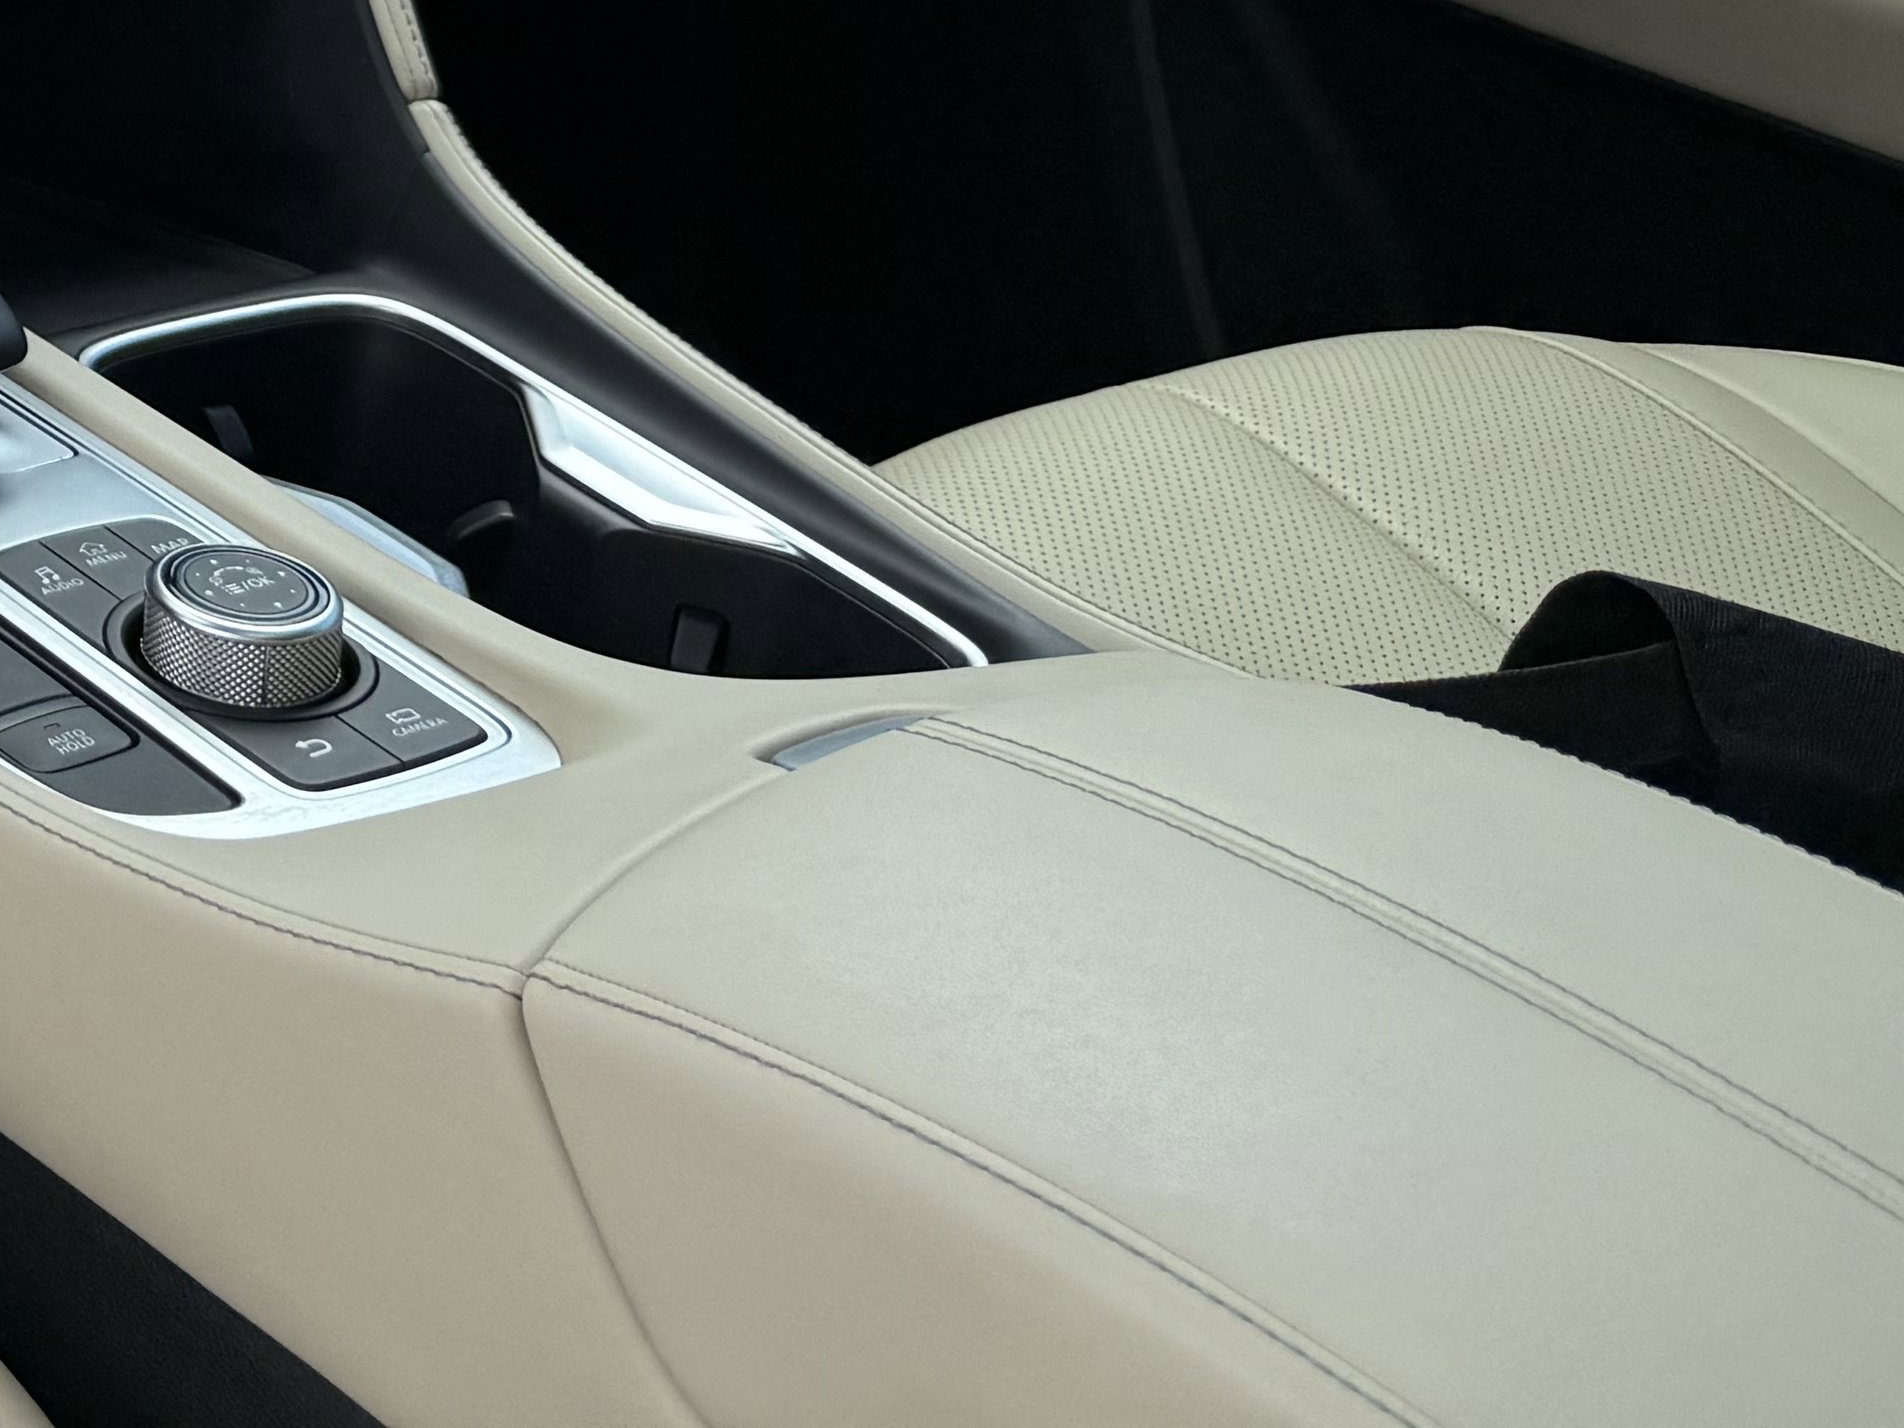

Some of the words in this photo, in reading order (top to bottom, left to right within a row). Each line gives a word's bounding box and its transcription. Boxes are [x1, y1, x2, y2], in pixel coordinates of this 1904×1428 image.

[151, 537, 189, 555] MAP
[85, 551, 128, 567] MENU
[40, 577, 85, 596] AUDIO
[47, 728, 89, 747] AUTO
[55, 736, 96, 756] HOLD
